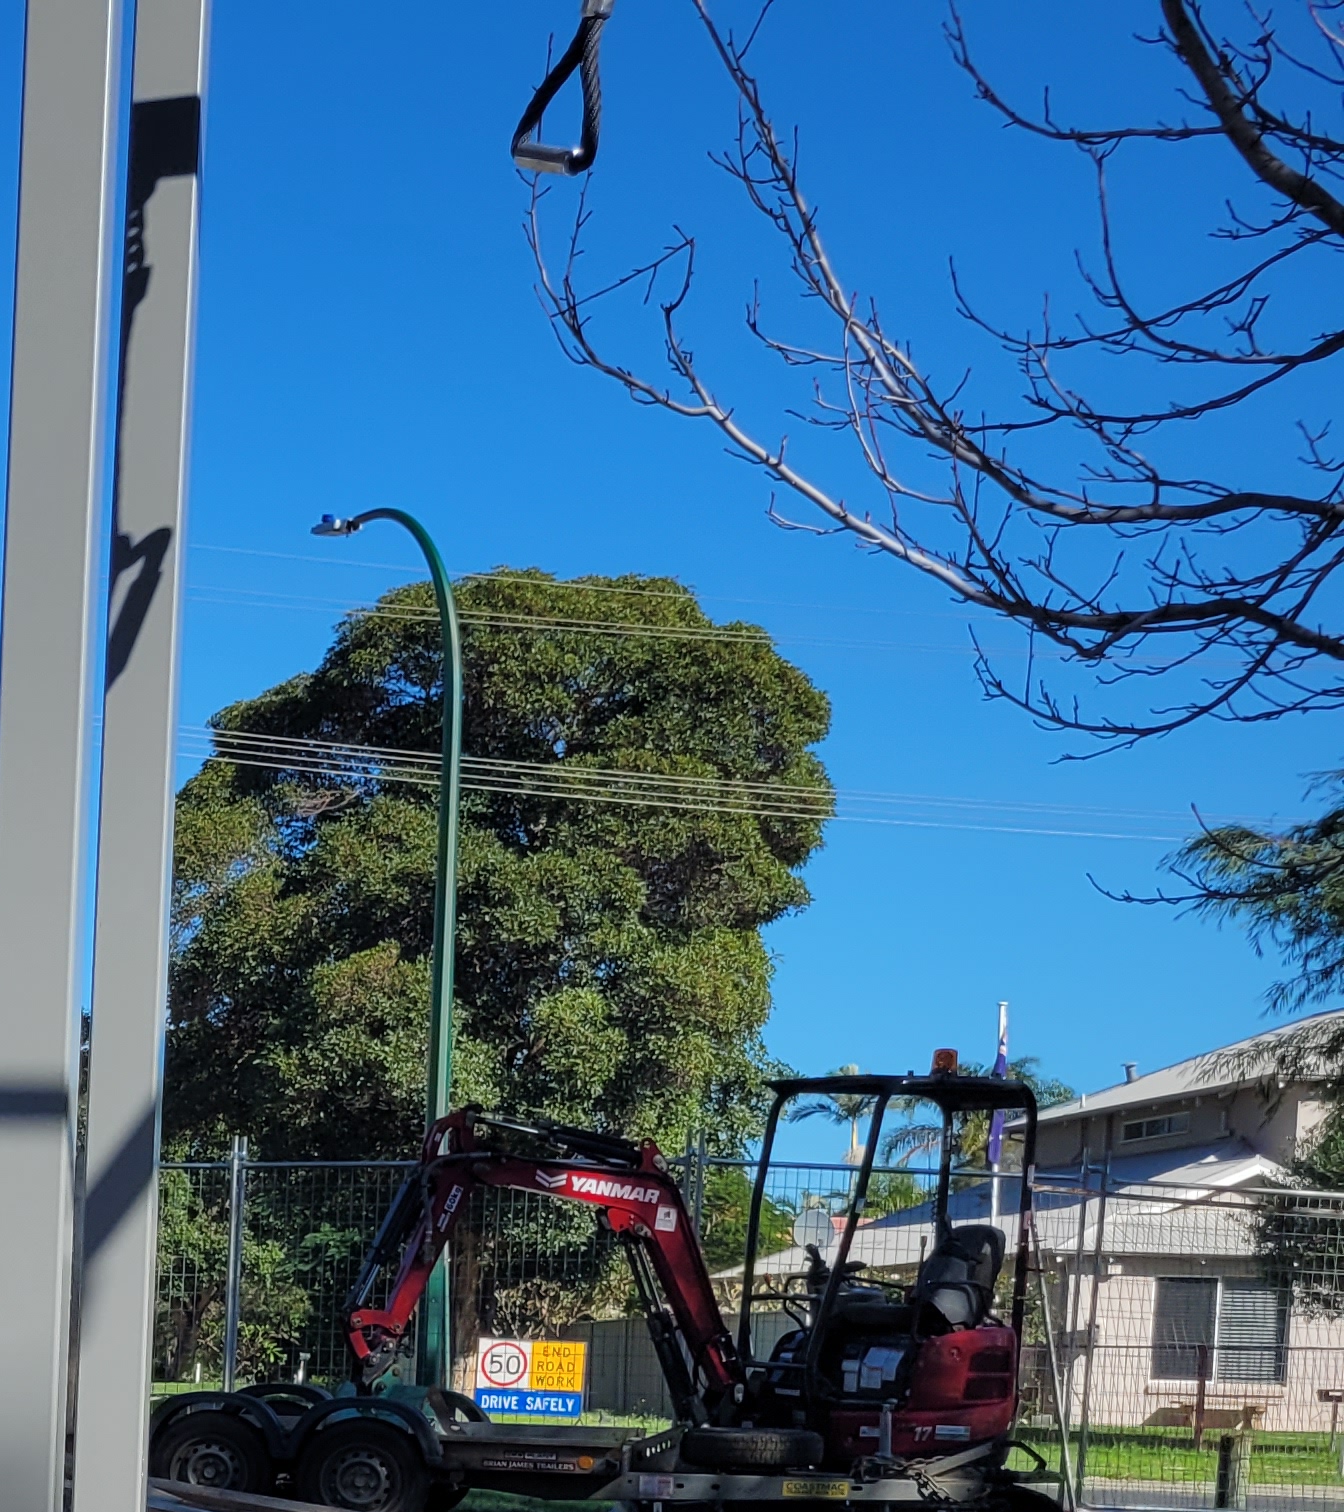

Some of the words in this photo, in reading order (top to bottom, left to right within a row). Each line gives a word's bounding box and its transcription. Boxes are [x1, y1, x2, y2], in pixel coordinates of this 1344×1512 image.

[571, 1175, 661, 1205] YANMAR
[543, 1347, 570, 1357] END
[489, 1354, 521, 1375] 50
[537, 1361, 575, 1372] ROAD
[535, 1376, 575, 1388] WORK
[480, 1395, 519, 1410] DRIVE
[525, 1396, 575, 1412] SAFELY
[914, 1426, 933, 1442] 17
[509, 1460, 533, 1469] JAMES
[786, 1482, 845, 1491] COASTMAC
